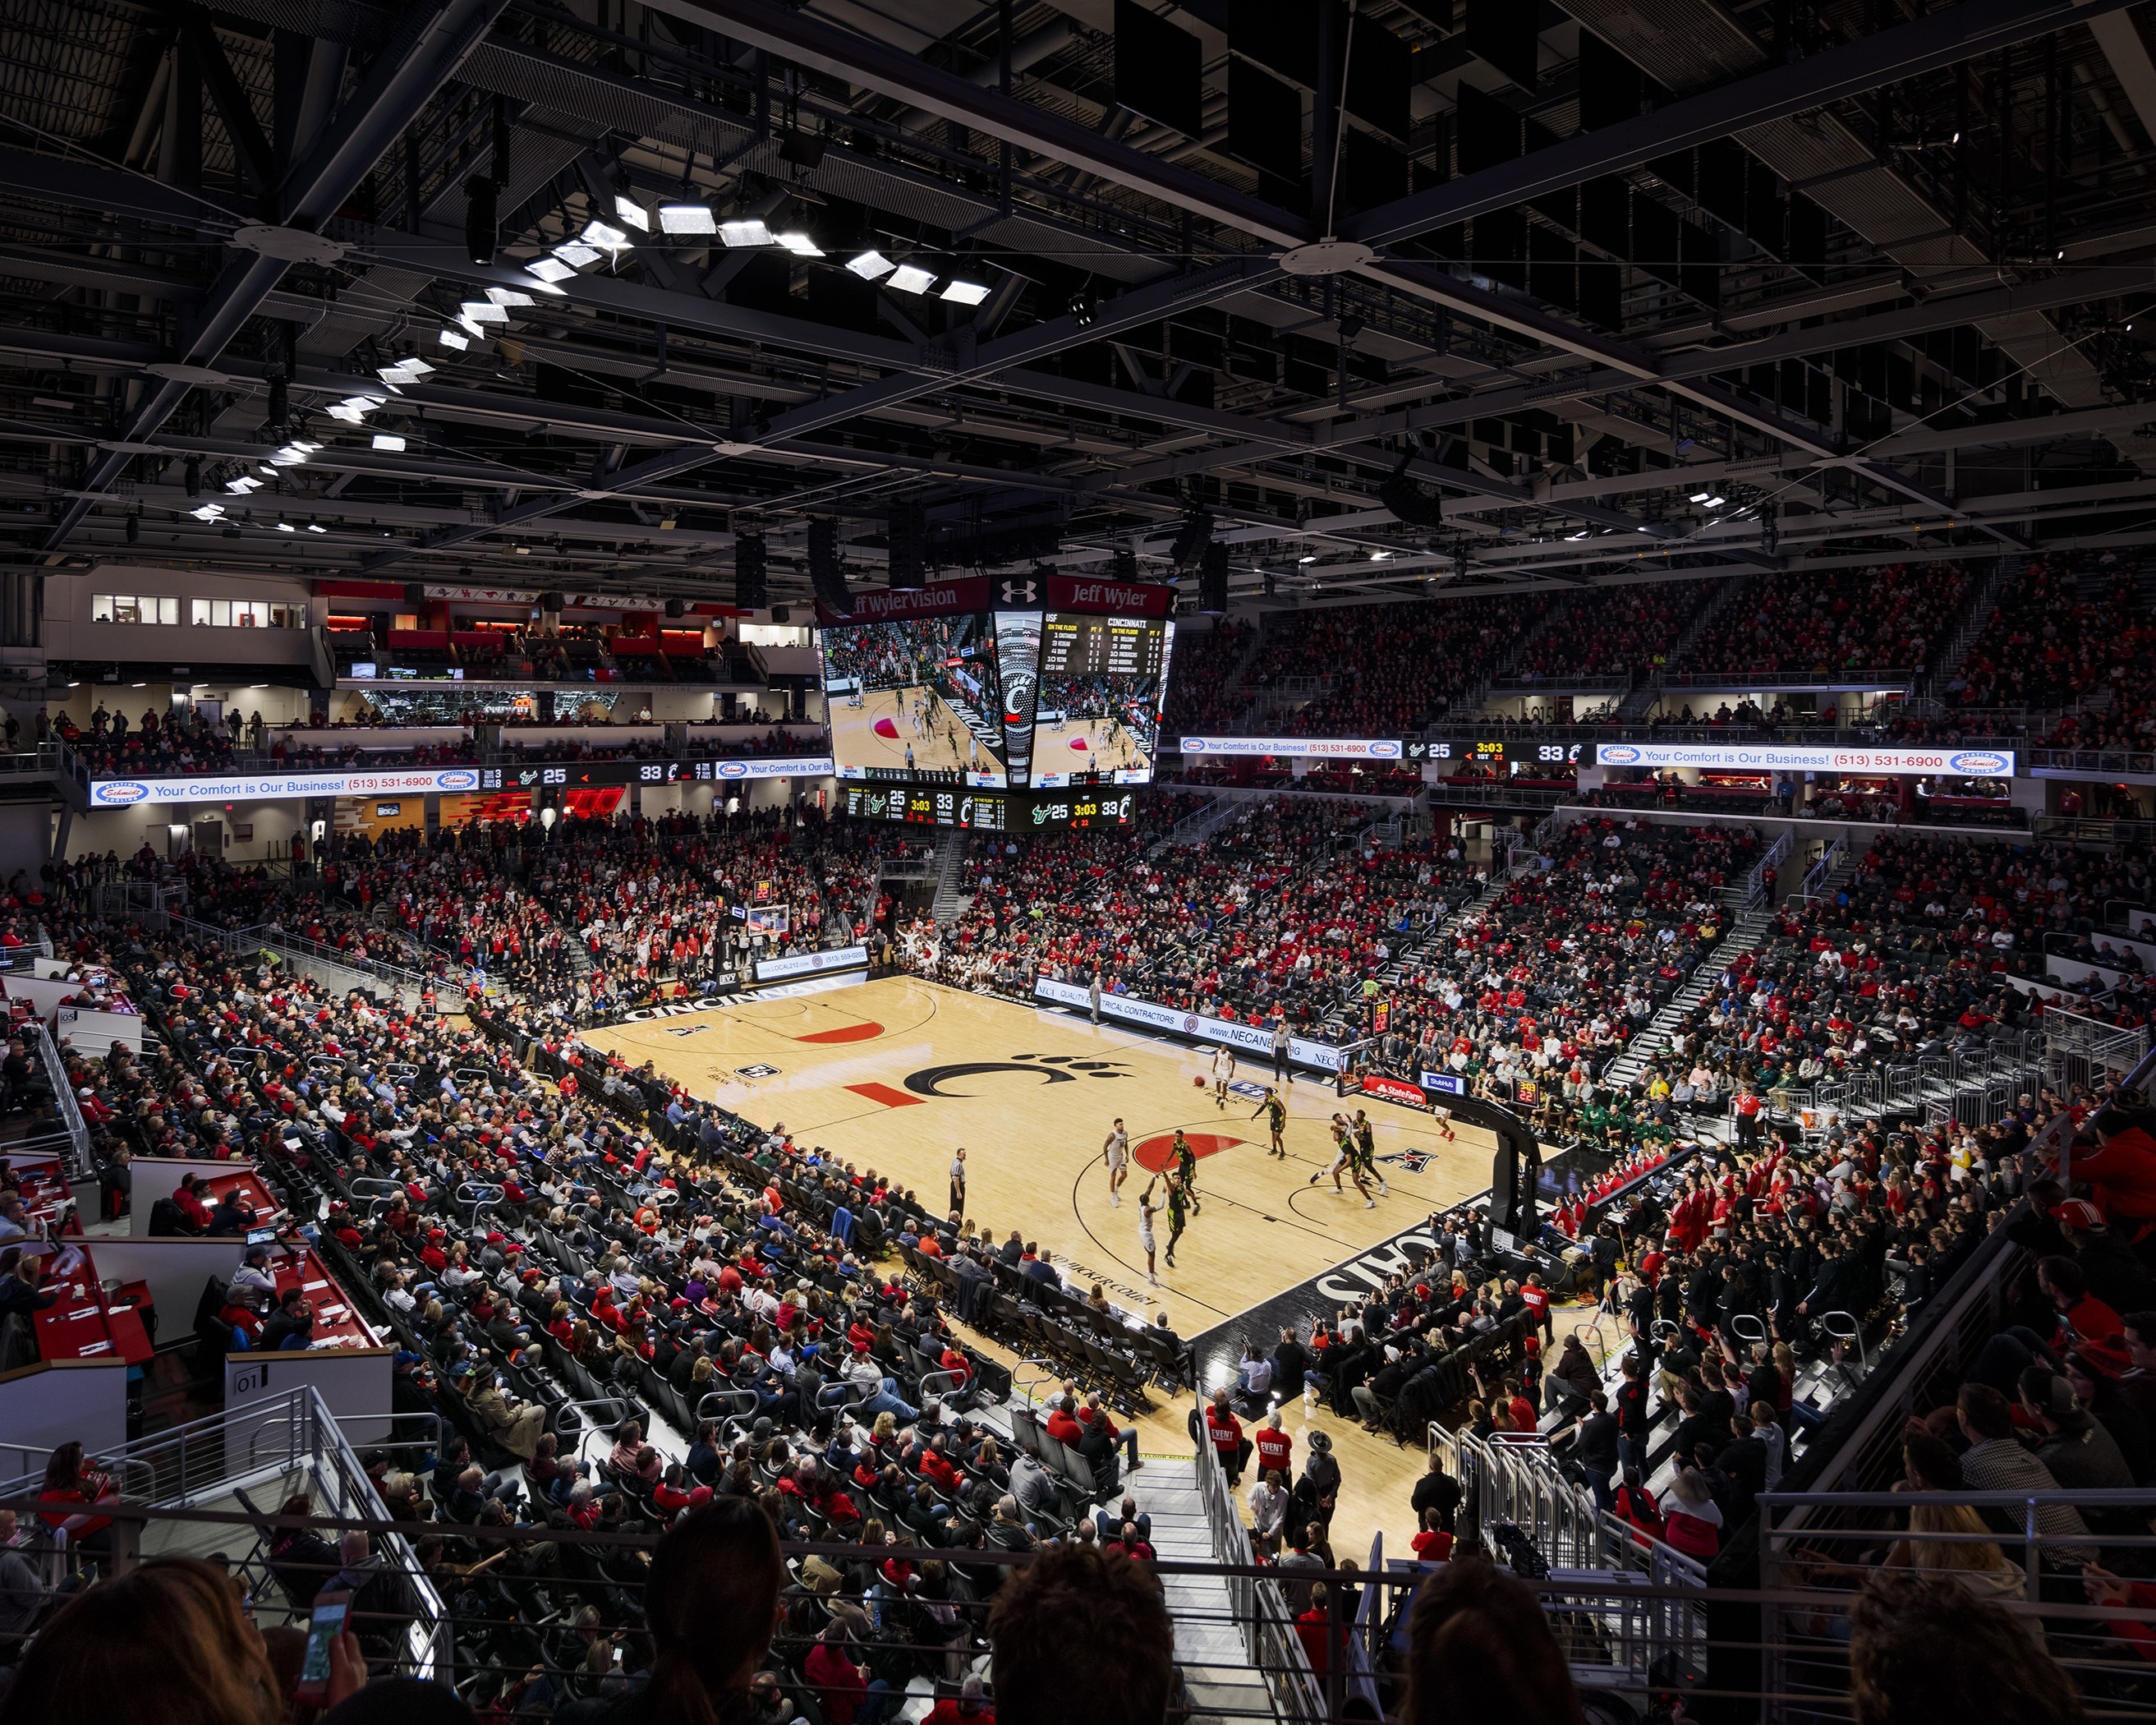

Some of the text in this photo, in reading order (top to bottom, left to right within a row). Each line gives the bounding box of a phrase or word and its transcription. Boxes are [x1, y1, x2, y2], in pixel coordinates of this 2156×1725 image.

[868, 586, 957, 617] Wyler Vision
[1072, 585, 1147, 610] Jeff Wyler
[1046, 614, 1057, 623] USF
[1108, 618, 1147, 629] CINCINNATI
[944, 698, 1003, 748] BEARCATS
[1207, 743, 1366, 754] Your Comfort is Our Business! (513) 531-6900
[1428, 743, 1450, 758] 25
[1477, 743, 1503, 753] 3:03
[1538, 745, 1563, 761] 33
[1607, 751, 1634, 759] Schmidt
[1645, 752, 1943, 767] Your Comfort is Our Business! (513) 531-6900
[696, 763, 701, 772] 4
[750, 764, 768, 775] Your
[769, 763, 798, 774] Comfort
[800, 763, 807, 772] is
[809, 763, 821, 772] Our
[1960, 758, 1998, 768] Schmidt
[494, 769, 502, 779] 3
[544, 769, 567, 784] 25
[641, 766, 662, 780] 33
[696, 771, 701, 780] 7
[444, 776, 470, 784] Schmidt
[494, 779, 502, 789] 8
[155, 776, 433, 797] Your Comfort is Our Business! (513) 531-6900
[106, 788, 141, 798] Schmidt
[890, 790, 905, 805] 25
[314, 799, 328, 807] 109
[911, 799, 930, 812] 3:03
[936, 794, 954, 810] 33
[1051, 804, 1068, 820] 25
[1074, 803, 1096, 816] 3:03
[1101, 801, 1118, 816] 33
[756, 889, 768, 899] 22
[825, 950, 866, 964] (513) 559-0200
[1038, 986, 1055, 996] NECA
[624, 978, 843, 1023] CINCINNATI
[1060, 990, 1175, 1026] QUALITY ETRICAL CONTRACTORS
[1377, 1003, 1389, 1014] 3:03
[62, 1013, 74, 1022] 05
[1375, 1014, 1387, 1033] 22
[1314, 1053, 1340, 1067] NECA
[707, 1074, 732, 1086] BANK
[1430, 1078, 1454, 1088] StubHub
[1520, 1082, 1536, 1092] 3:03
[1234, 1095, 1264, 1107] THIR
[1519, 1090, 1533, 1102] 22
[1538, 1256, 1551, 1266] Bell
[1069, 1262, 1115, 1287] JUCKER
[1110, 1283, 1161, 1306] COURT
[1524, 1292, 1542, 1303] EVENT
[237, 1374, 256, 1393] 01
[1211, 1428, 1234, 1439] EVENT
[1260, 1442, 1284, 1454] EVENT
